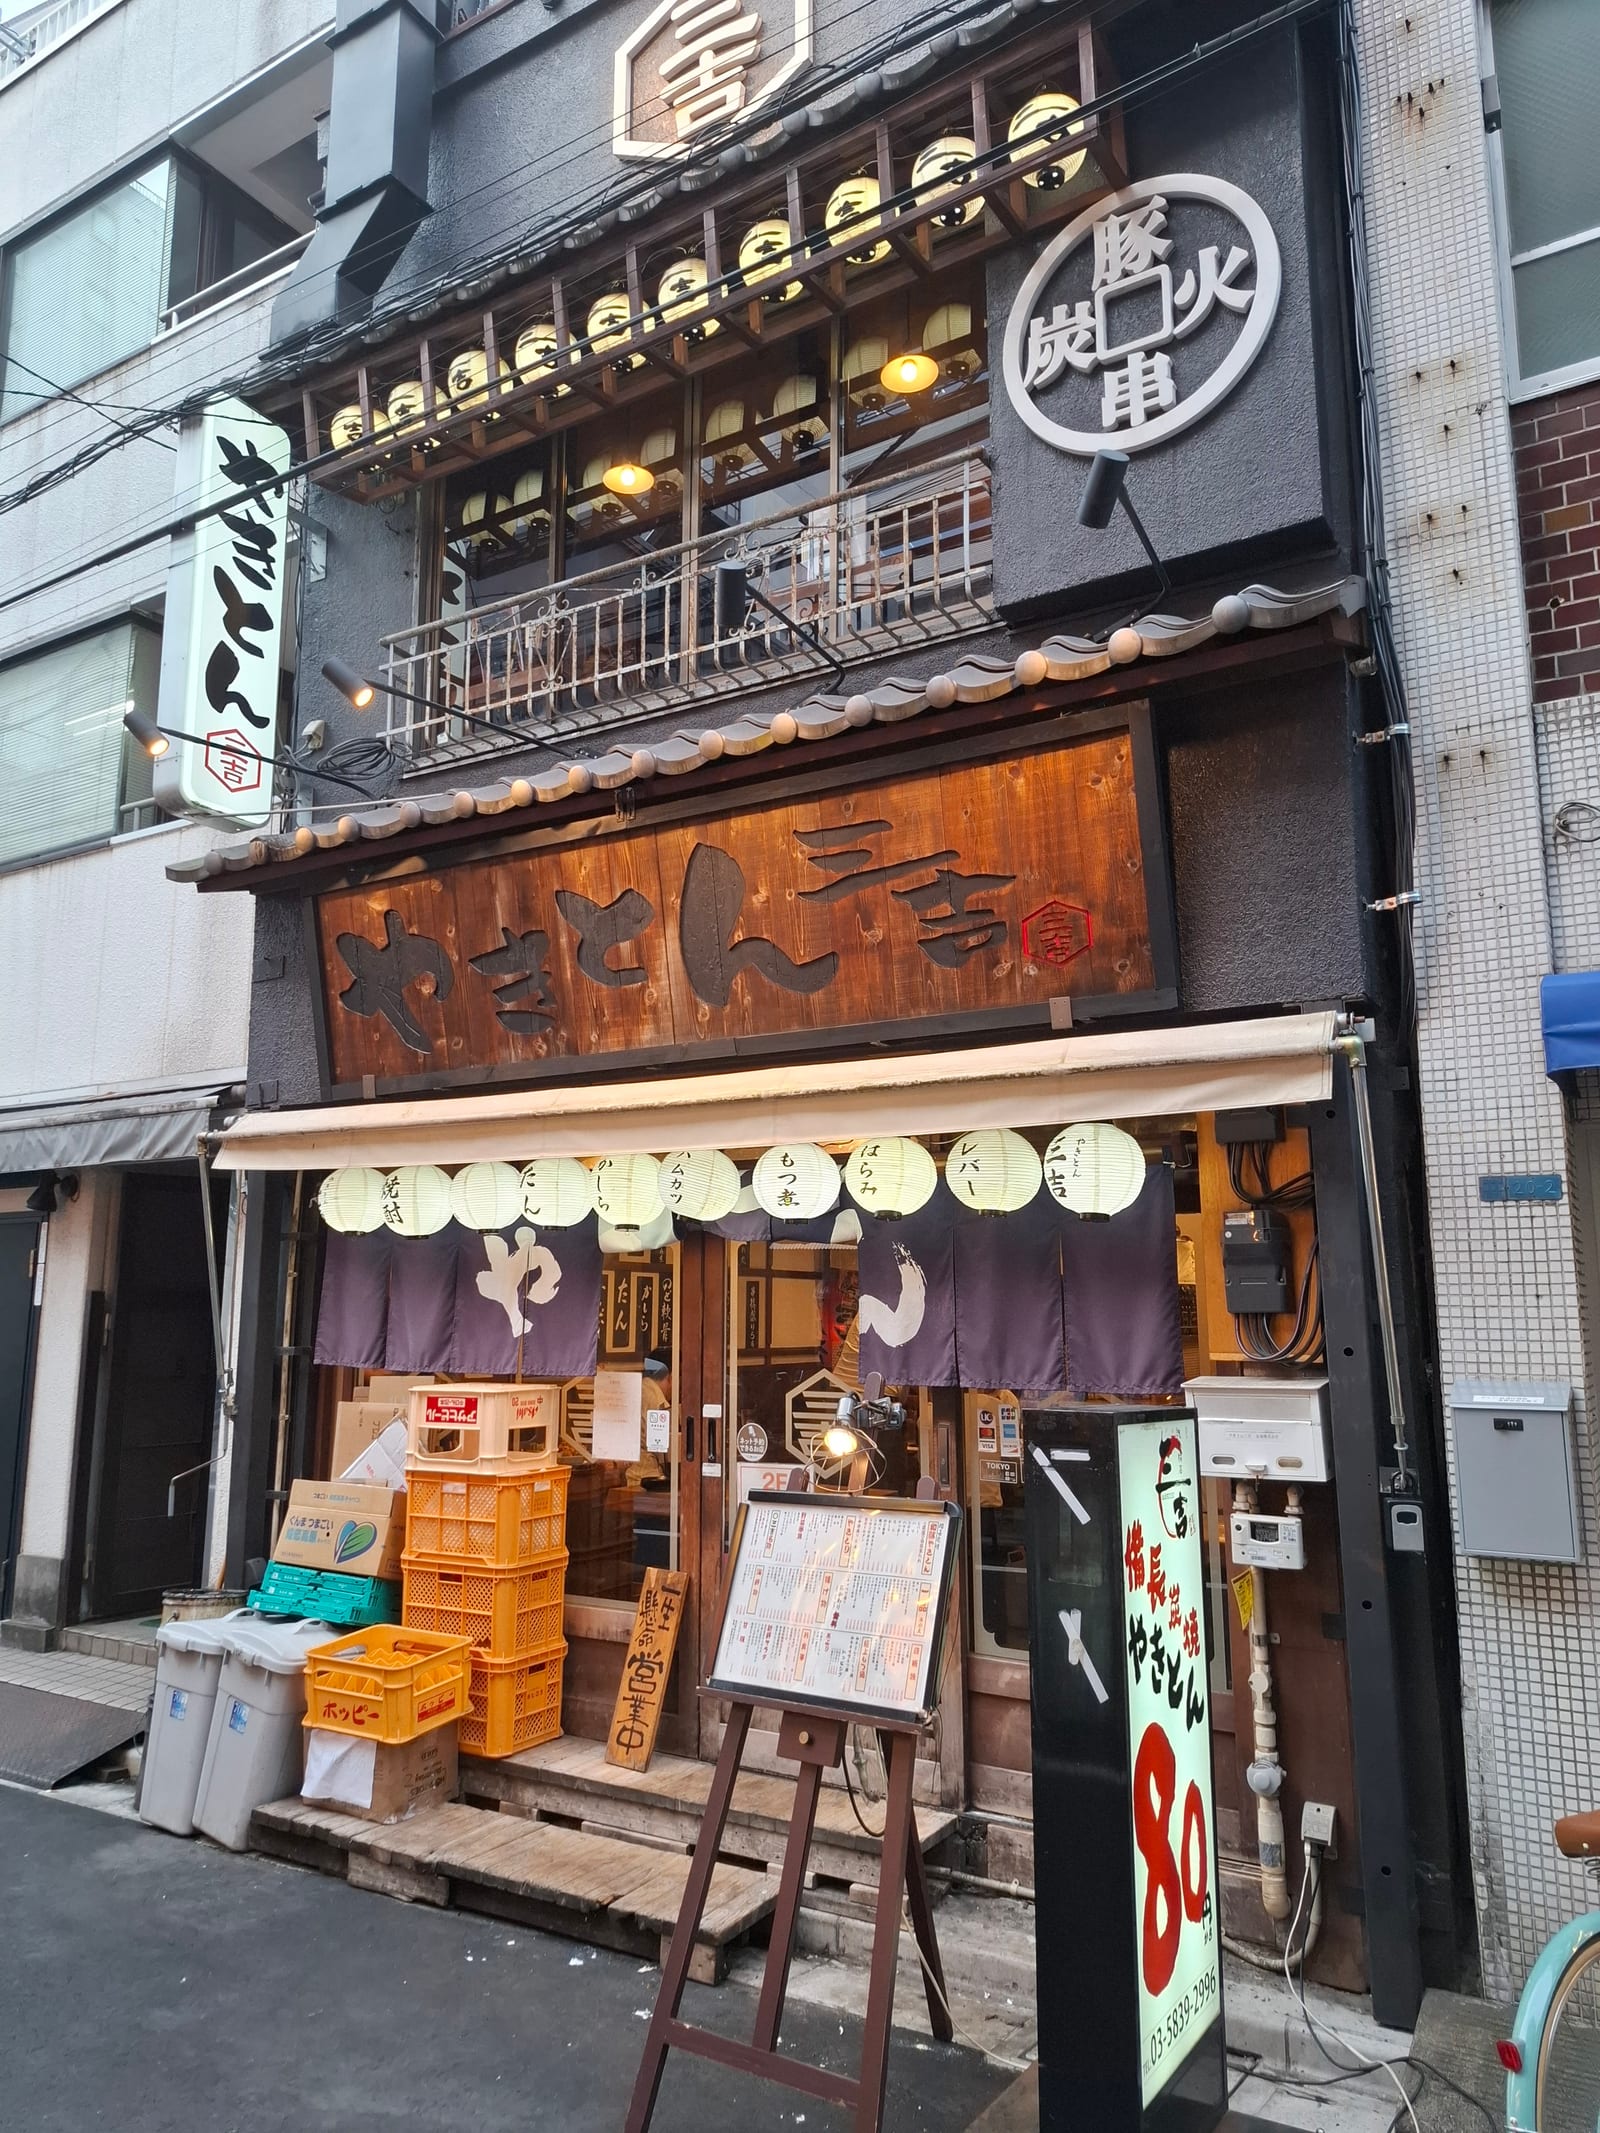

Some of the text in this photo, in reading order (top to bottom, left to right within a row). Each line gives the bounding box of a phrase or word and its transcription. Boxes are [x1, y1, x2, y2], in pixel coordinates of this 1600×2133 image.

[1092, 195, 1175, 290] 豚
[1173, 245, 1255, 339] 火
[1023, 300, 1098, 391] 炭
[1102, 351, 1176, 430] 串
[205, 434, 284, 730] やきとん
[596, 1157, 613, 1213] かしら
[777, 1151, 800, 1207] もつ煮
[860, 1144, 878, 1196] はらみ
[958, 1141, 981, 1197] レバー
[1047, 1134, 1068, 1199] 三吉
[1072, 1137, 1087, 1179] やきとん
[382, 1174, 404, 1225] 焼酎
[519, 1166, 541, 1216] たん
[475, 1226, 562, 1339] や
[614, 1276, 629, 1331] たん
[640, 1284, 653, 1332] かしら
[427, 1408, 476, 1423] アサヒビール
[986, 1462, 1010, 1470] TOKYO
[1128, 1612, 1206, 1733] やきとん
[322, 1699, 380, 1726] ホッピー
[616, 1649, 664, 1756] 営業中
[1150, 1966, 1217, 2066] 03-5839-2996
